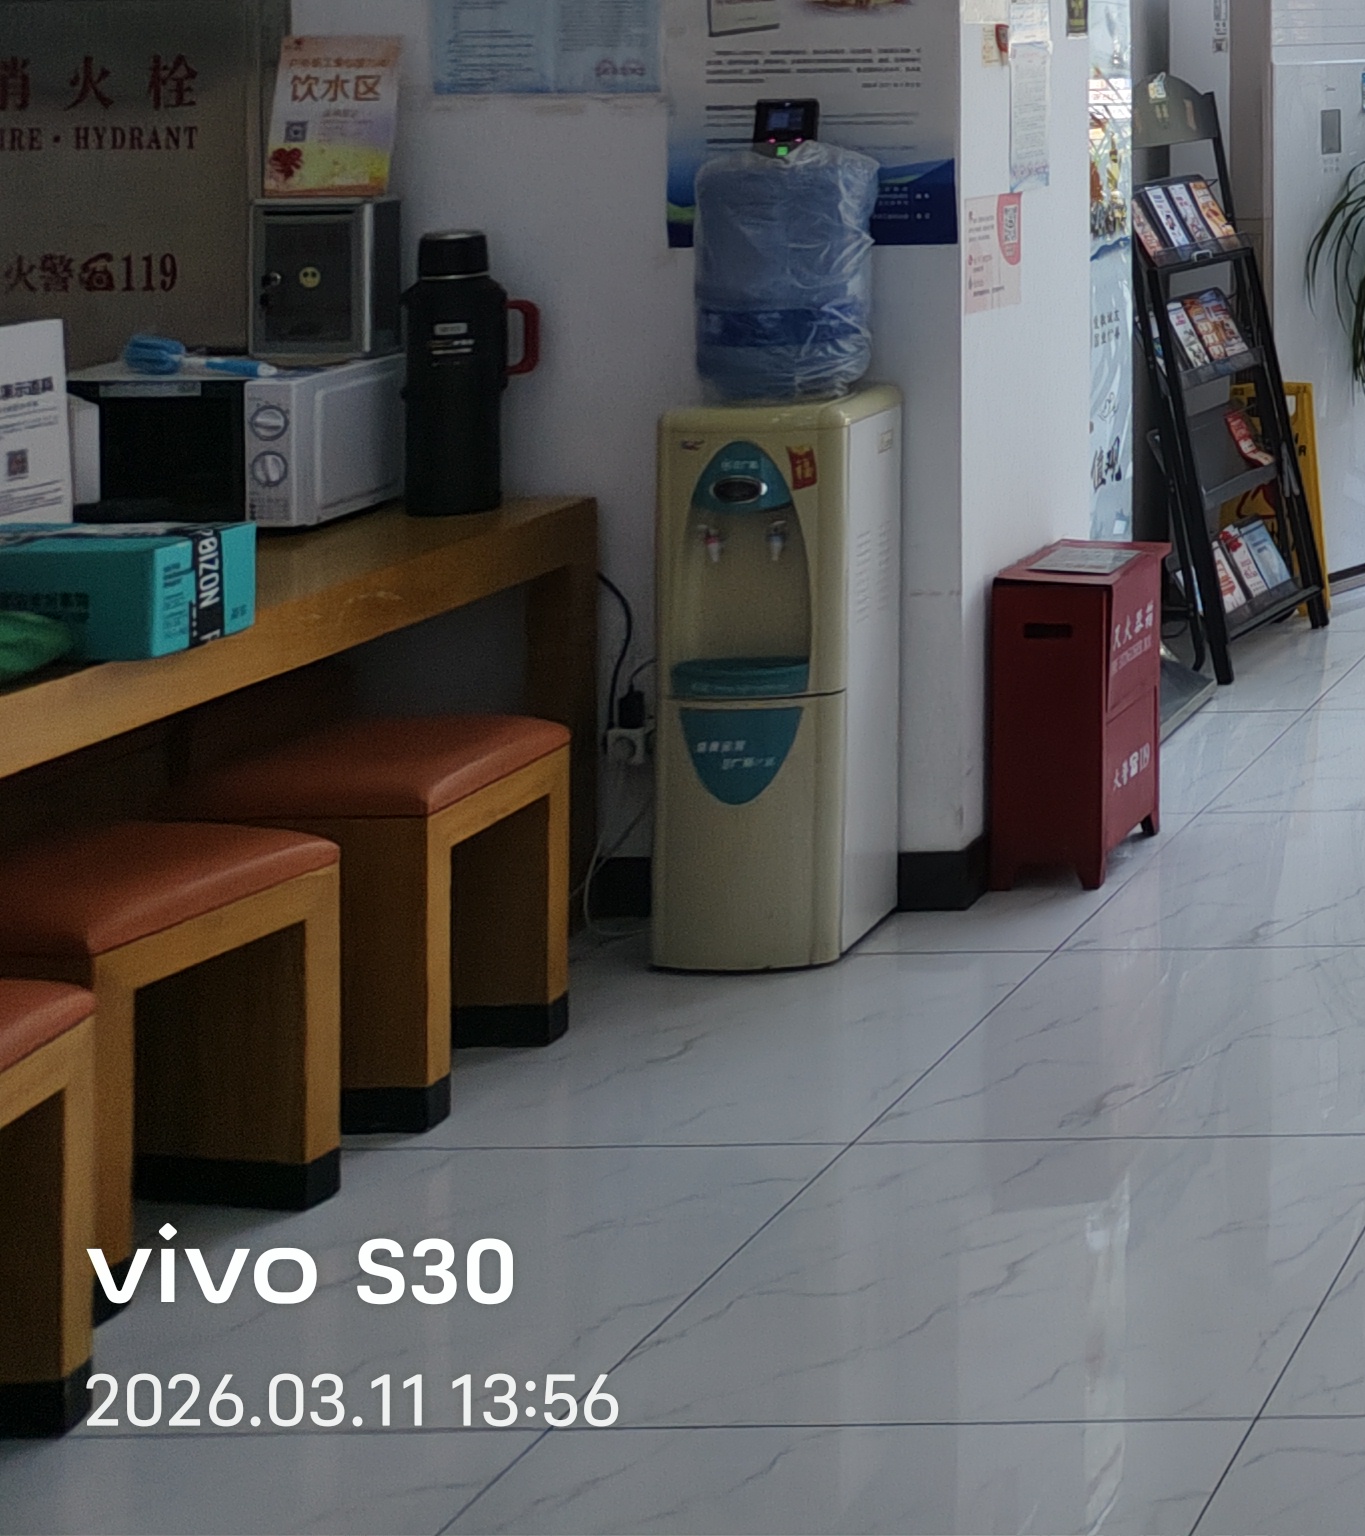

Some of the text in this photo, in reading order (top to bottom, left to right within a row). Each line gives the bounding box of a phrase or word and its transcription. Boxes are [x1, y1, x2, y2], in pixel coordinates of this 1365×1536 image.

[0, 53, 198, 111] 消火栓
[290, 73, 383, 103] 饮水区
[75, 125, 199, 151] HYDRANT
[5, 252, 179, 293] 火警 119
